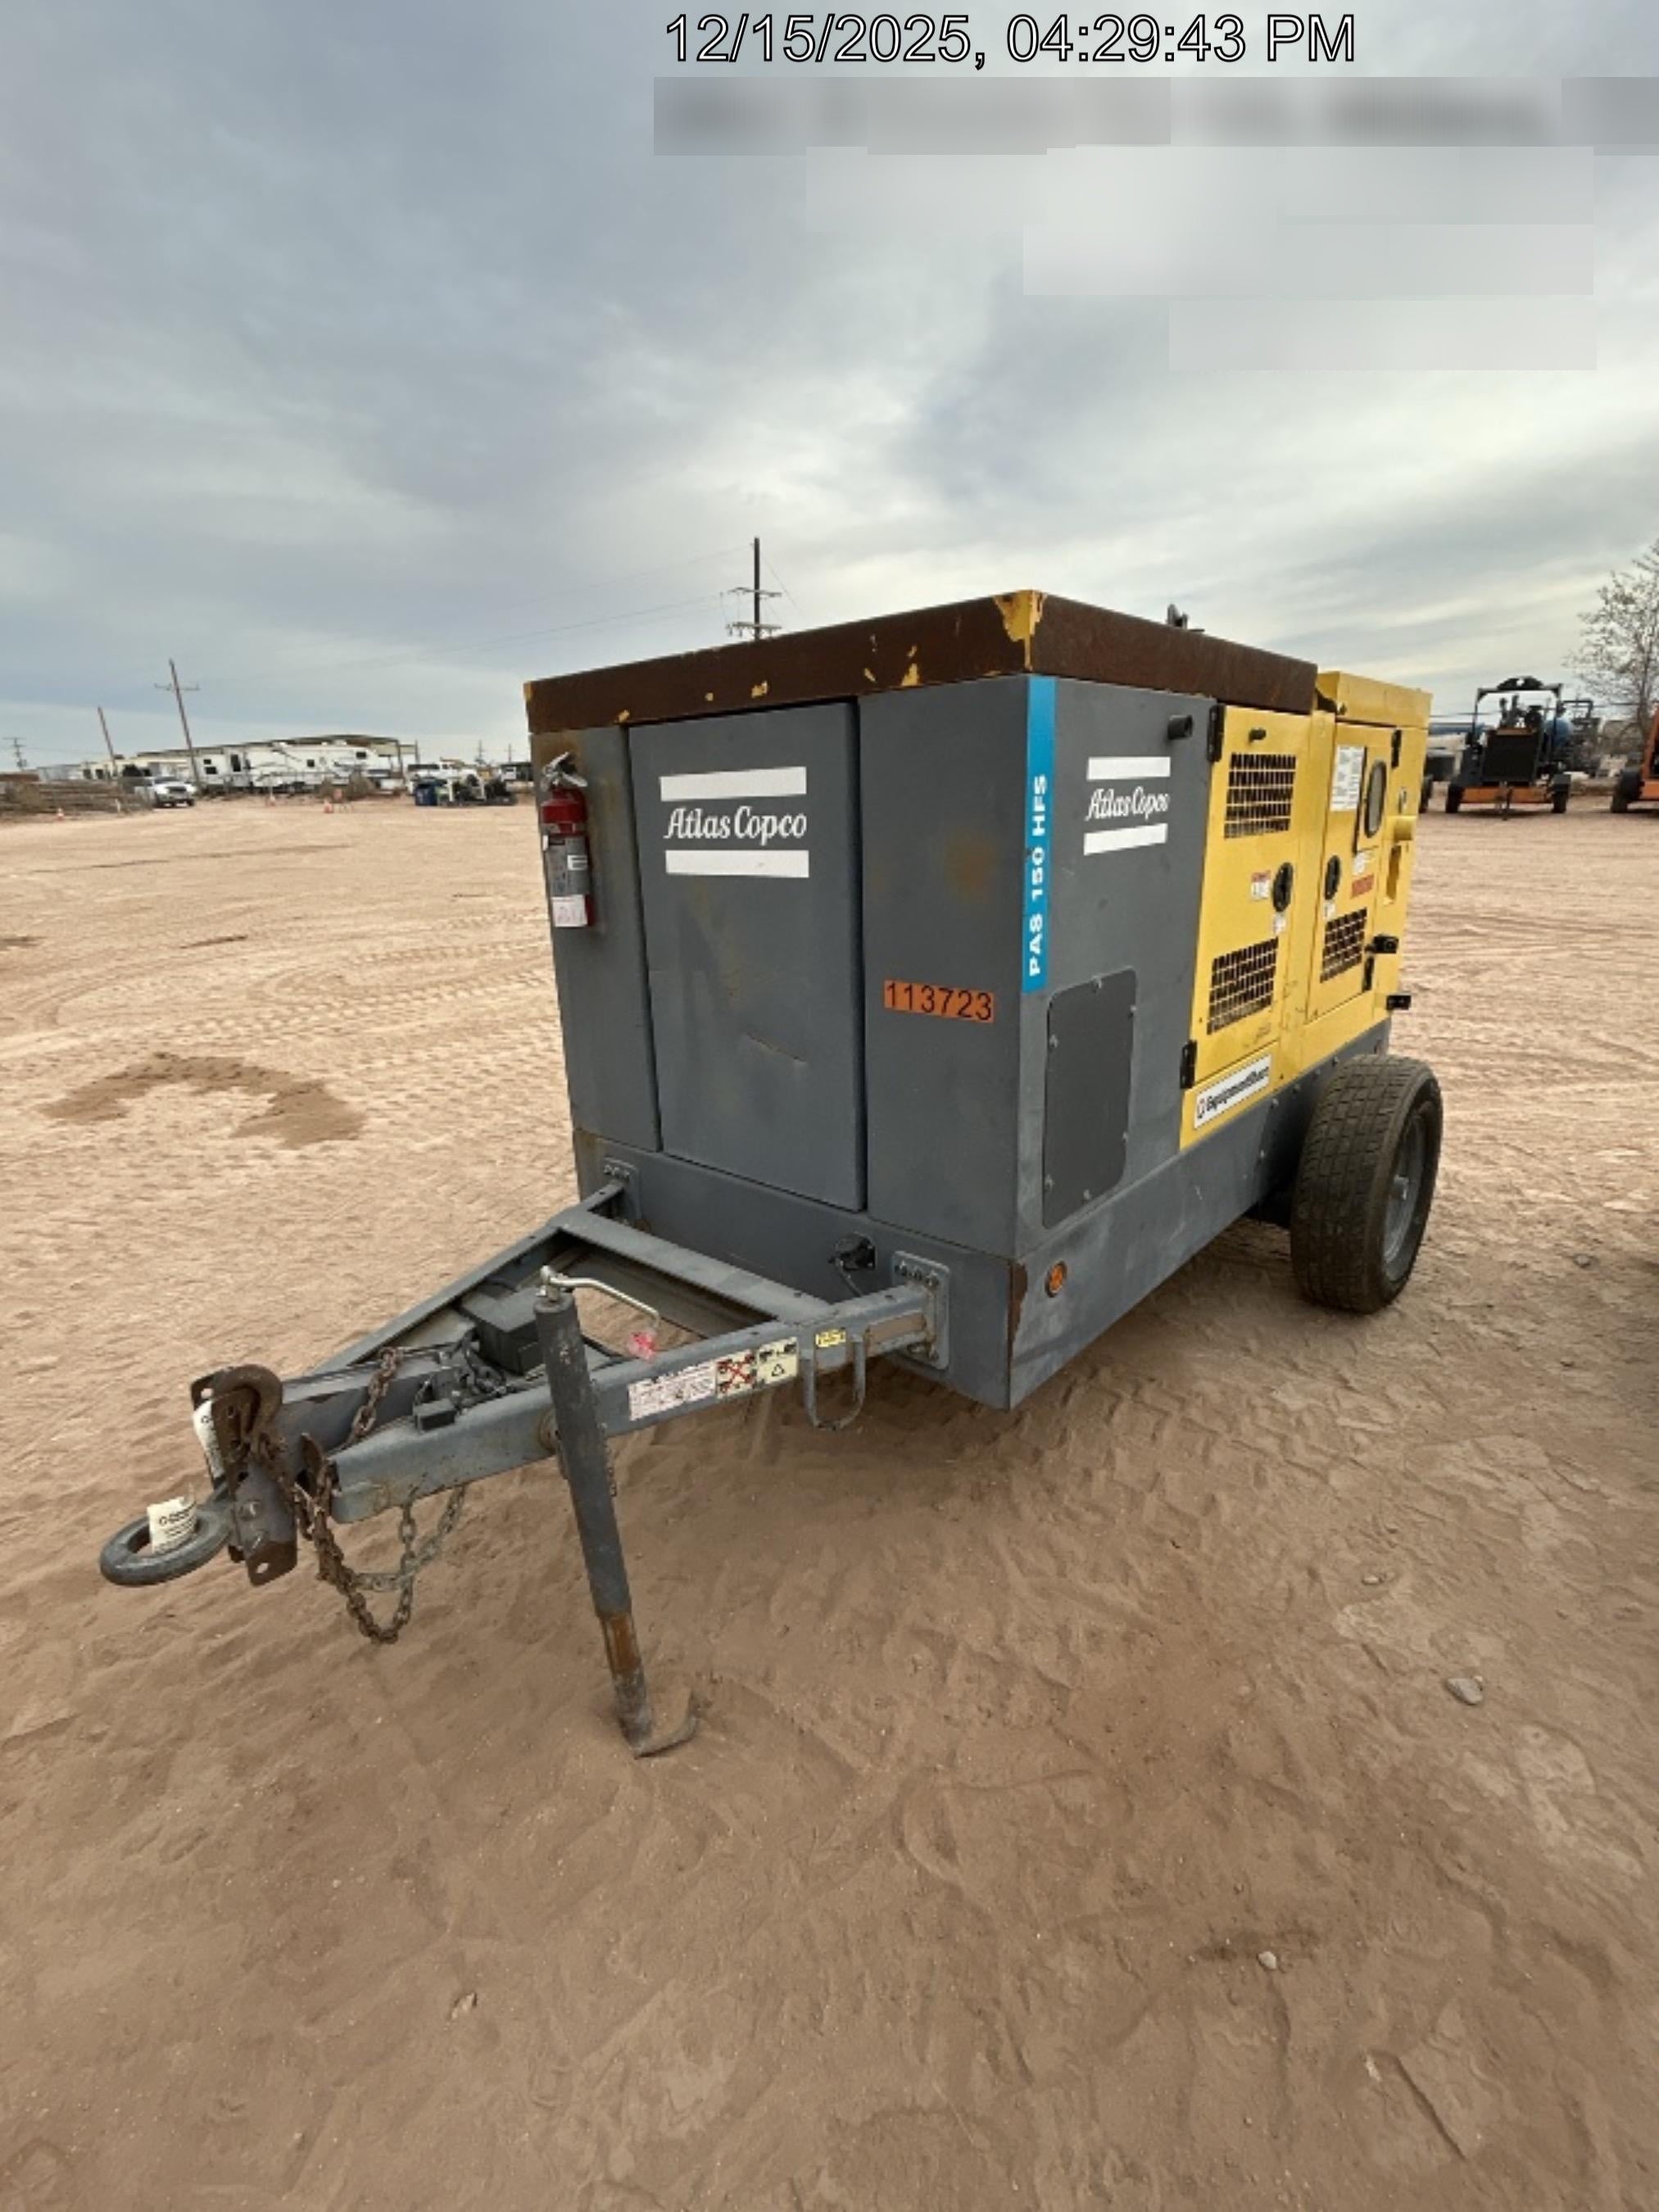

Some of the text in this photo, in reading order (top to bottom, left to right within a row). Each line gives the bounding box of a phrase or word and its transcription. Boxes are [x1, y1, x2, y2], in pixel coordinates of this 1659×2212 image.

[1085, 787, 1131, 820] Atlas
[663, 805, 808, 846] Atlas Copco
[1029, 774, 1047, 977] PAS 150 HFS
[886, 981, 991, 1021] 113723
